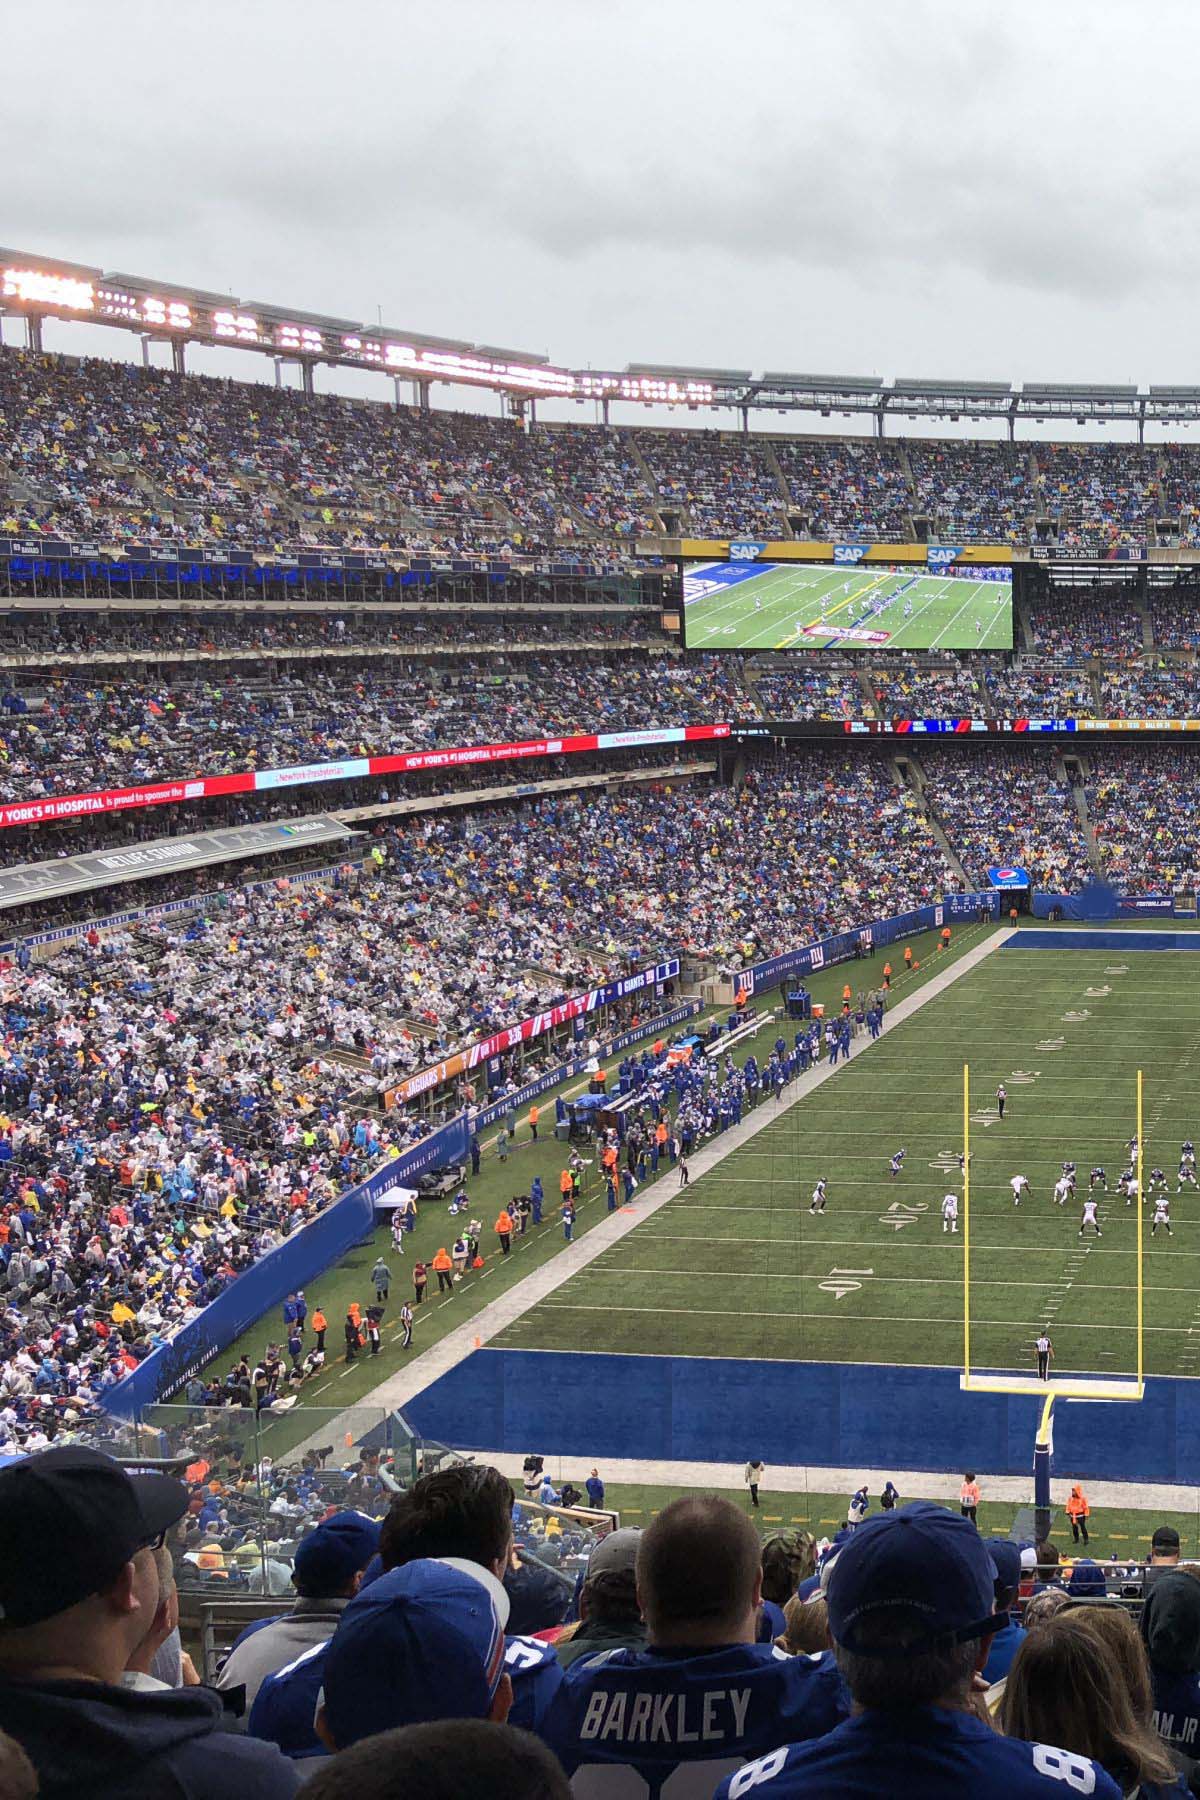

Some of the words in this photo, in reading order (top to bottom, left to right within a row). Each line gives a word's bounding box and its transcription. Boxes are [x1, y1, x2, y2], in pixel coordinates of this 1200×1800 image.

[730, 544, 760, 561] SAP
[834, 547, 864, 563] SAP
[927, 549, 956, 565] SAP
[406, 757, 422, 767] NEW
[424, 754, 448, 765] YORK'S
[458, 750, 490, 762] HOSPITAL
[7, 804, 42, 819] YORK'S
[45, 804, 54, 815] #1
[56, 797, 104, 813] HOSPITAL
[114, 794, 134, 808] proud
[145, 789, 171, 802] sponsor
[171, 786, 182, 798] the
[97, 851, 151, 870] METLIFE
[147, 842, 201, 861] STADIUM
[624, 974, 645, 993] GIANTS
[407, 1067, 438, 1098] JAGUARS
[441, 1063, 447, 1079] 3
[878, 1201, 929, 1225] 20
[818, 1267, 873, 1292] 10
[579, 1687, 752, 1743] BARKLEY
